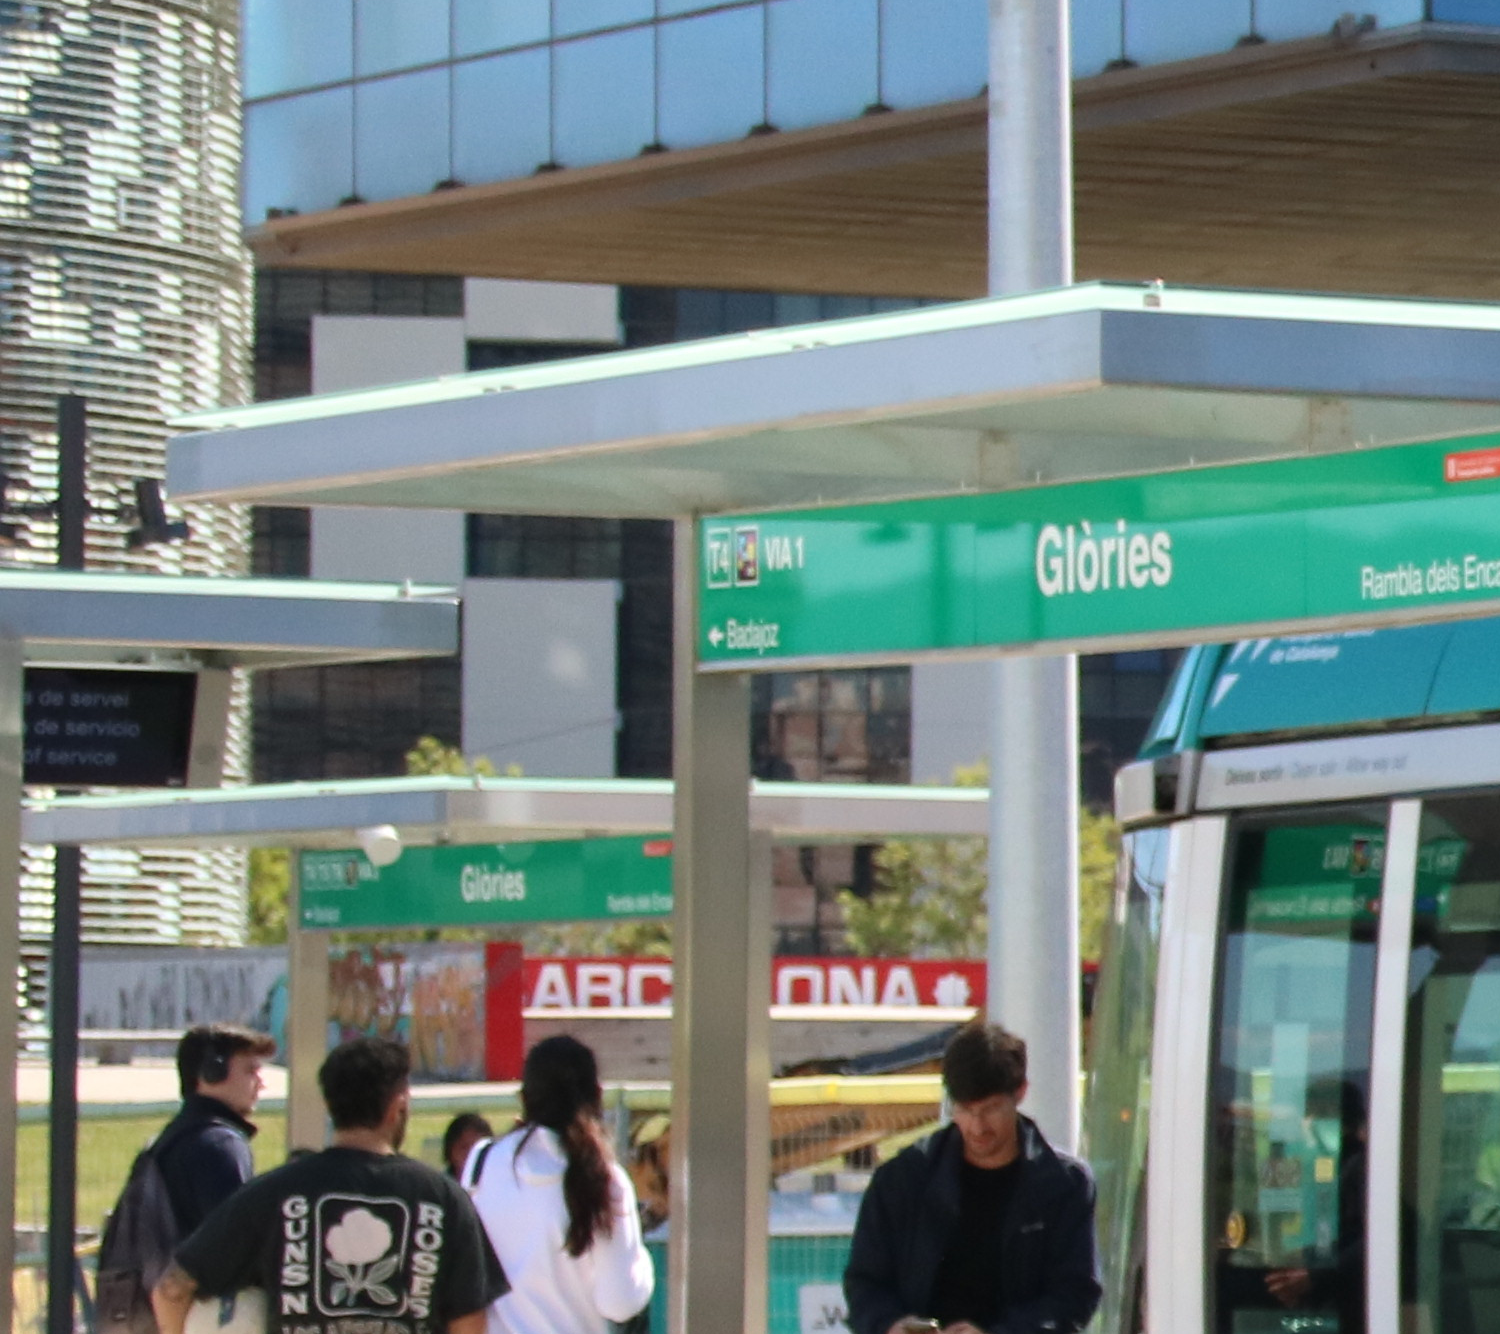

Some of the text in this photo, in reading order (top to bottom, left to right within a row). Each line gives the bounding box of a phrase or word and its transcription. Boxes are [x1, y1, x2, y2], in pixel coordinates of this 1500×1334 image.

[709, 536, 805, 575] T4 VIA 1
[1036, 519, 1173, 597] Glòries
[1361, 562, 1423, 601] Rambla
[1426, 559, 1460, 594] dels
[727, 618, 780, 656] Badajoz
[282, 1195, 310, 1287] GUNS
[407, 1202, 445, 1319] ROSES
